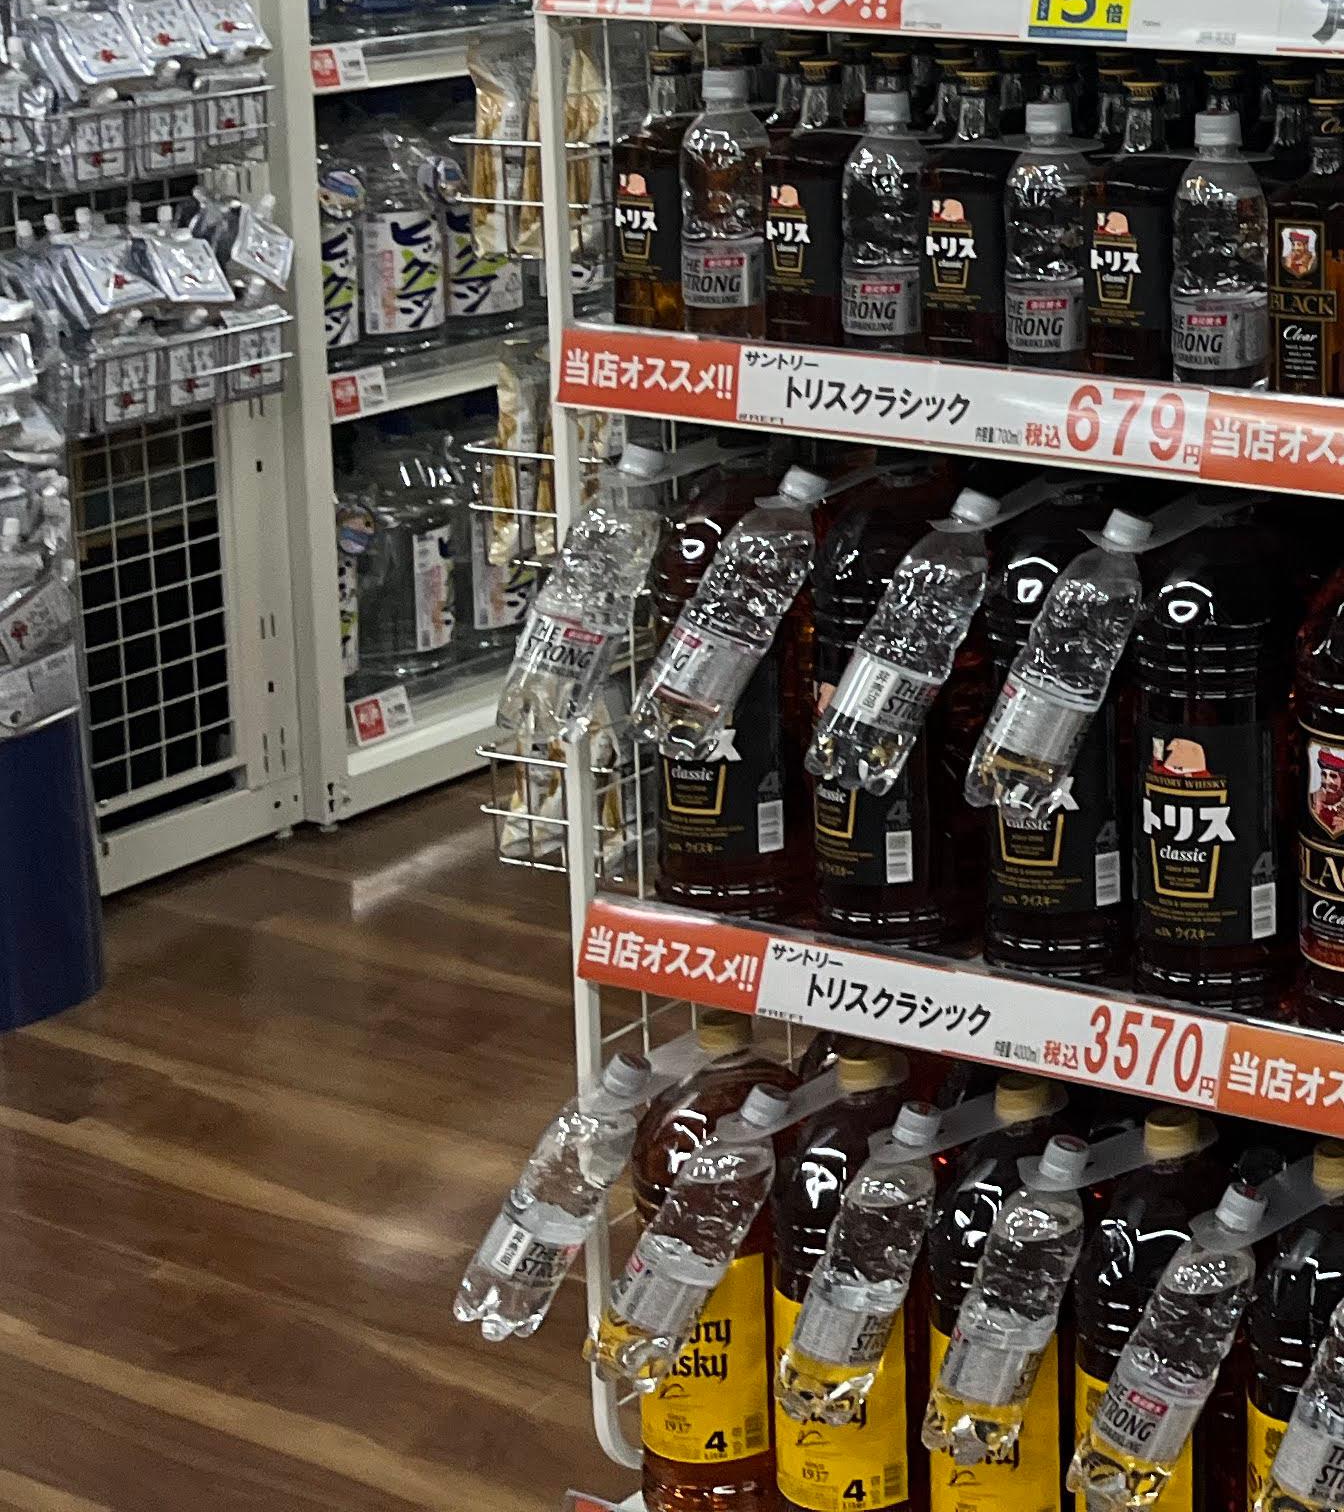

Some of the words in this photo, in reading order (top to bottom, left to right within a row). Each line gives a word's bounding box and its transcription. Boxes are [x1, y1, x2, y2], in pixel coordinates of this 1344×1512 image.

[1106, 3, 1123, 24] 倍
[615, 208, 658, 232] トリス
[766, 220, 811, 244] トリス
[926, 236, 977, 260] トリス
[1090, 249, 1141, 274] トリス
[683, 274, 741, 294] TRONG
[1271, 291, 1333, 316] BLACK
[1173, 330, 1222, 354] TRONG
[1283, 325, 1318, 343] Clear
[745, 351, 819, 371] サントリー
[786, 376, 970, 425] トリスクラシック
[1025, 421, 1061, 449] 税込
[1066, 384, 1186, 462] 679
[525, 636, 595, 668] STRONG
[671, 764, 714, 782] classic
[1143, 798, 1236, 842] トリス
[1159, 844, 1208, 863] classic
[772, 942, 844, 968] サントリー
[806, 974, 991, 1036] トリスクラシック
[1043, 1038, 1079, 1071] 税込
[1084, 1005, 1203, 1093] 3570
[704, 1430, 728, 1453] 4
[842, 1478, 867, 1503] 4
